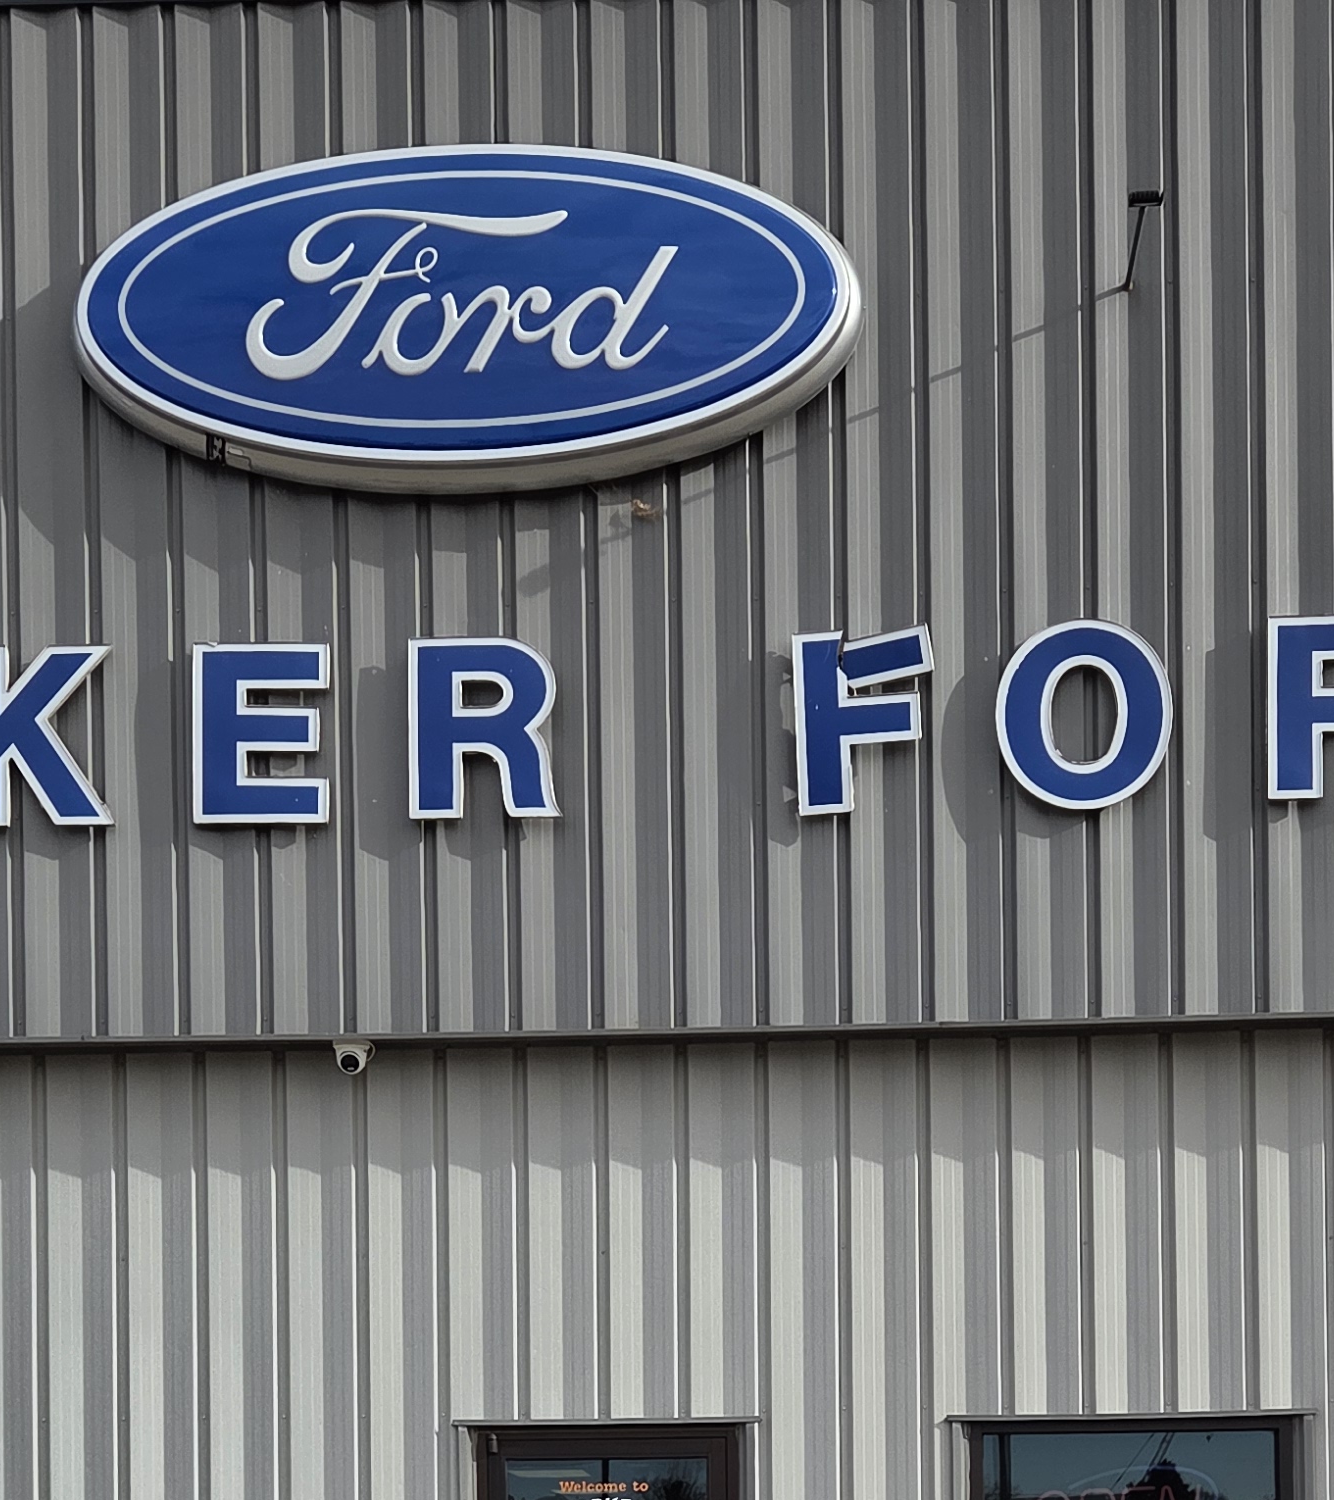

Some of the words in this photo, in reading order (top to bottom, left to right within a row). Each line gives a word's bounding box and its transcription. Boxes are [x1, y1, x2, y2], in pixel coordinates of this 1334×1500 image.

[244, 207, 679, 381] Ford
[559, 1481, 627, 1493] Welcome
[632, 1481, 649, 1492] to
